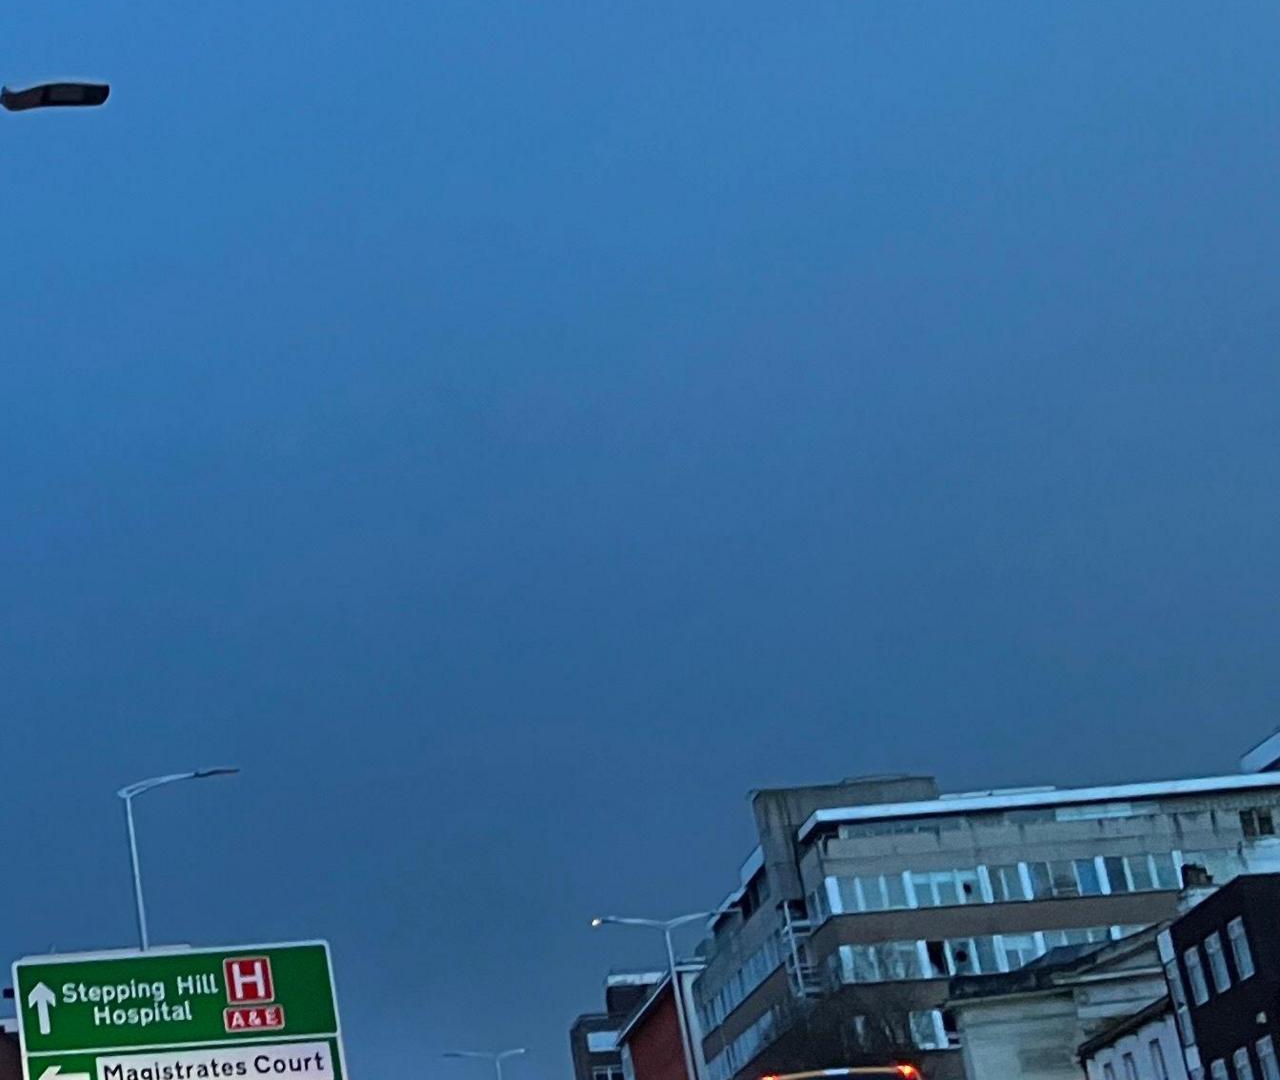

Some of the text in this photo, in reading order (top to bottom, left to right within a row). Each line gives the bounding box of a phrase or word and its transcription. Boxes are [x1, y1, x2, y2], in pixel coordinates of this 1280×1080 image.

[61, 973, 219, 1004] Stepping Hill
[231, 961, 266, 1000] H
[93, 1000, 193, 1027] Hospital
[103, 1051, 325, 1080] Magistrates Court
